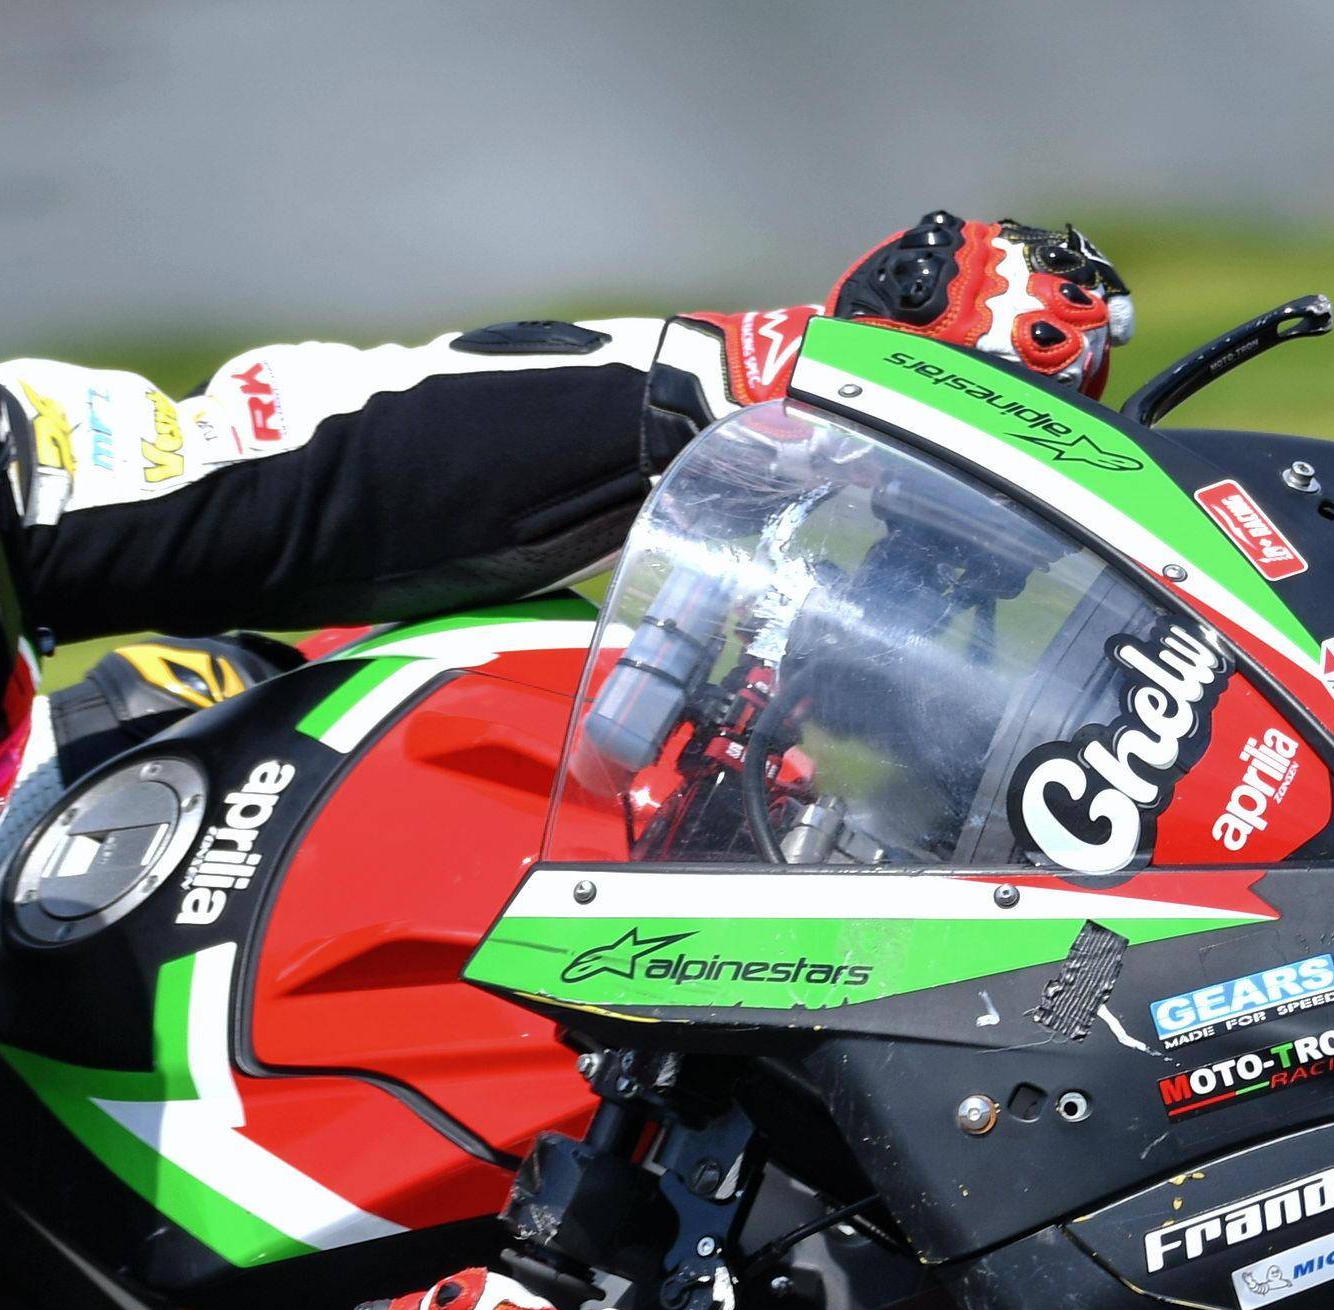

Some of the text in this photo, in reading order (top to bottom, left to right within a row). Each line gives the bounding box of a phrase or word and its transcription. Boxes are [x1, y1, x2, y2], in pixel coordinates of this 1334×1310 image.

[883, 352, 1073, 438] alpinestars
[1212, 728, 1299, 851] aprilia
[175, 759, 296, 925] aprilia
[643, 952, 874, 986] alpinestars
[1155, 955, 1334, 1031] GEARS
[1164, 1026, 1216, 1050] MADE
[1226, 1011, 1267, 1031] FOR
